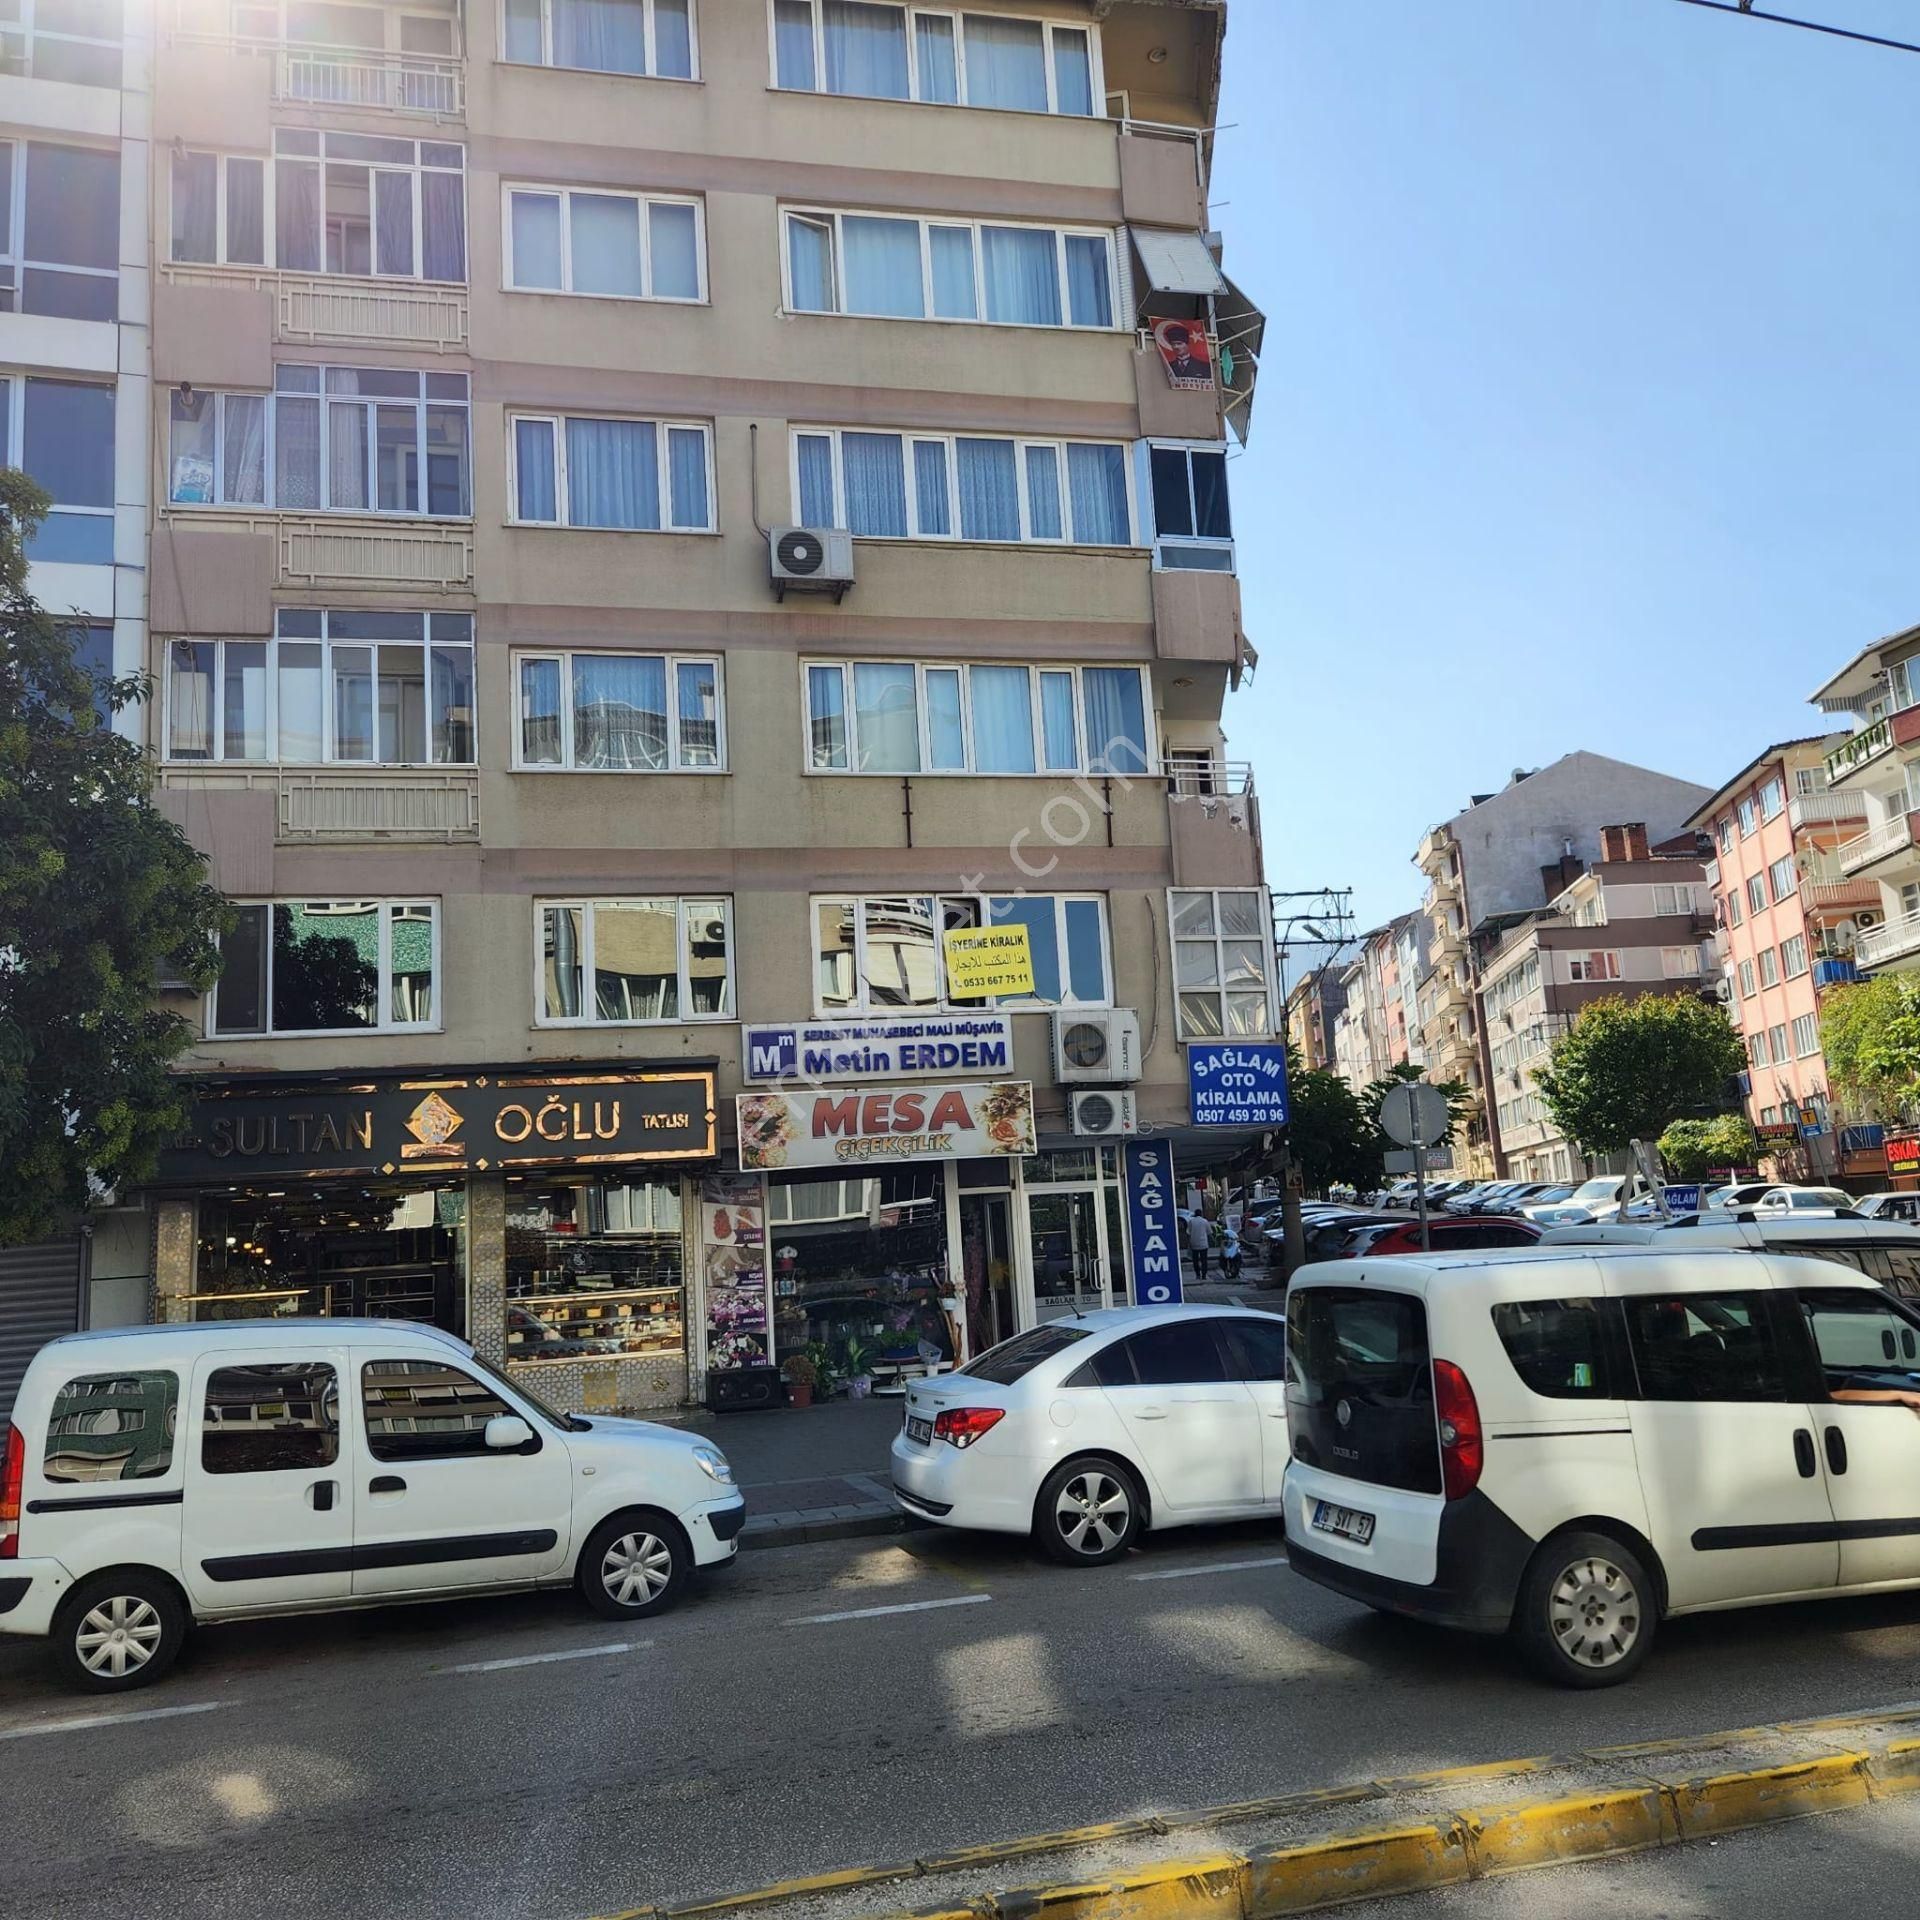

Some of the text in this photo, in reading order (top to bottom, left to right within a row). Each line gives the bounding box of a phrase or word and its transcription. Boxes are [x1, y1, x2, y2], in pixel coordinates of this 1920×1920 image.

[949, 934, 1024, 953] İŞYERİNE KİRALIK
[984, 953, 1011, 969] المكتب
[1013, 951, 1026, 964] هذا
[964, 974, 1028, 987] 0533 667 75 11
[804, 1019, 1004, 1042] SERBEST MUHASEBECİ MALİ MÜŞAVİR
[804, 1041, 1006, 1075] Metin ERDEM
[1193, 1047, 1280, 1079] SAĞLAM
[1221, 1073, 1256, 1087] OTO
[1196, 1089, 1282, 1106] KİRALAMA
[811, 1090, 976, 1139] MESA
[1196, 1109, 1284, 1122] 0507 459 20 96
[1804, 1112, 1813, 1123] T
[209, 1111, 373, 1158] SULTAN
[495, 1094, 620, 1143] OĞLU
[834, 1132, 953, 1162] ÇİÇEKÇİLİK
[1665, 1192, 1697, 1205] AĞLAM
[1138, 1151, 1169, 1273] SAĞLAM
